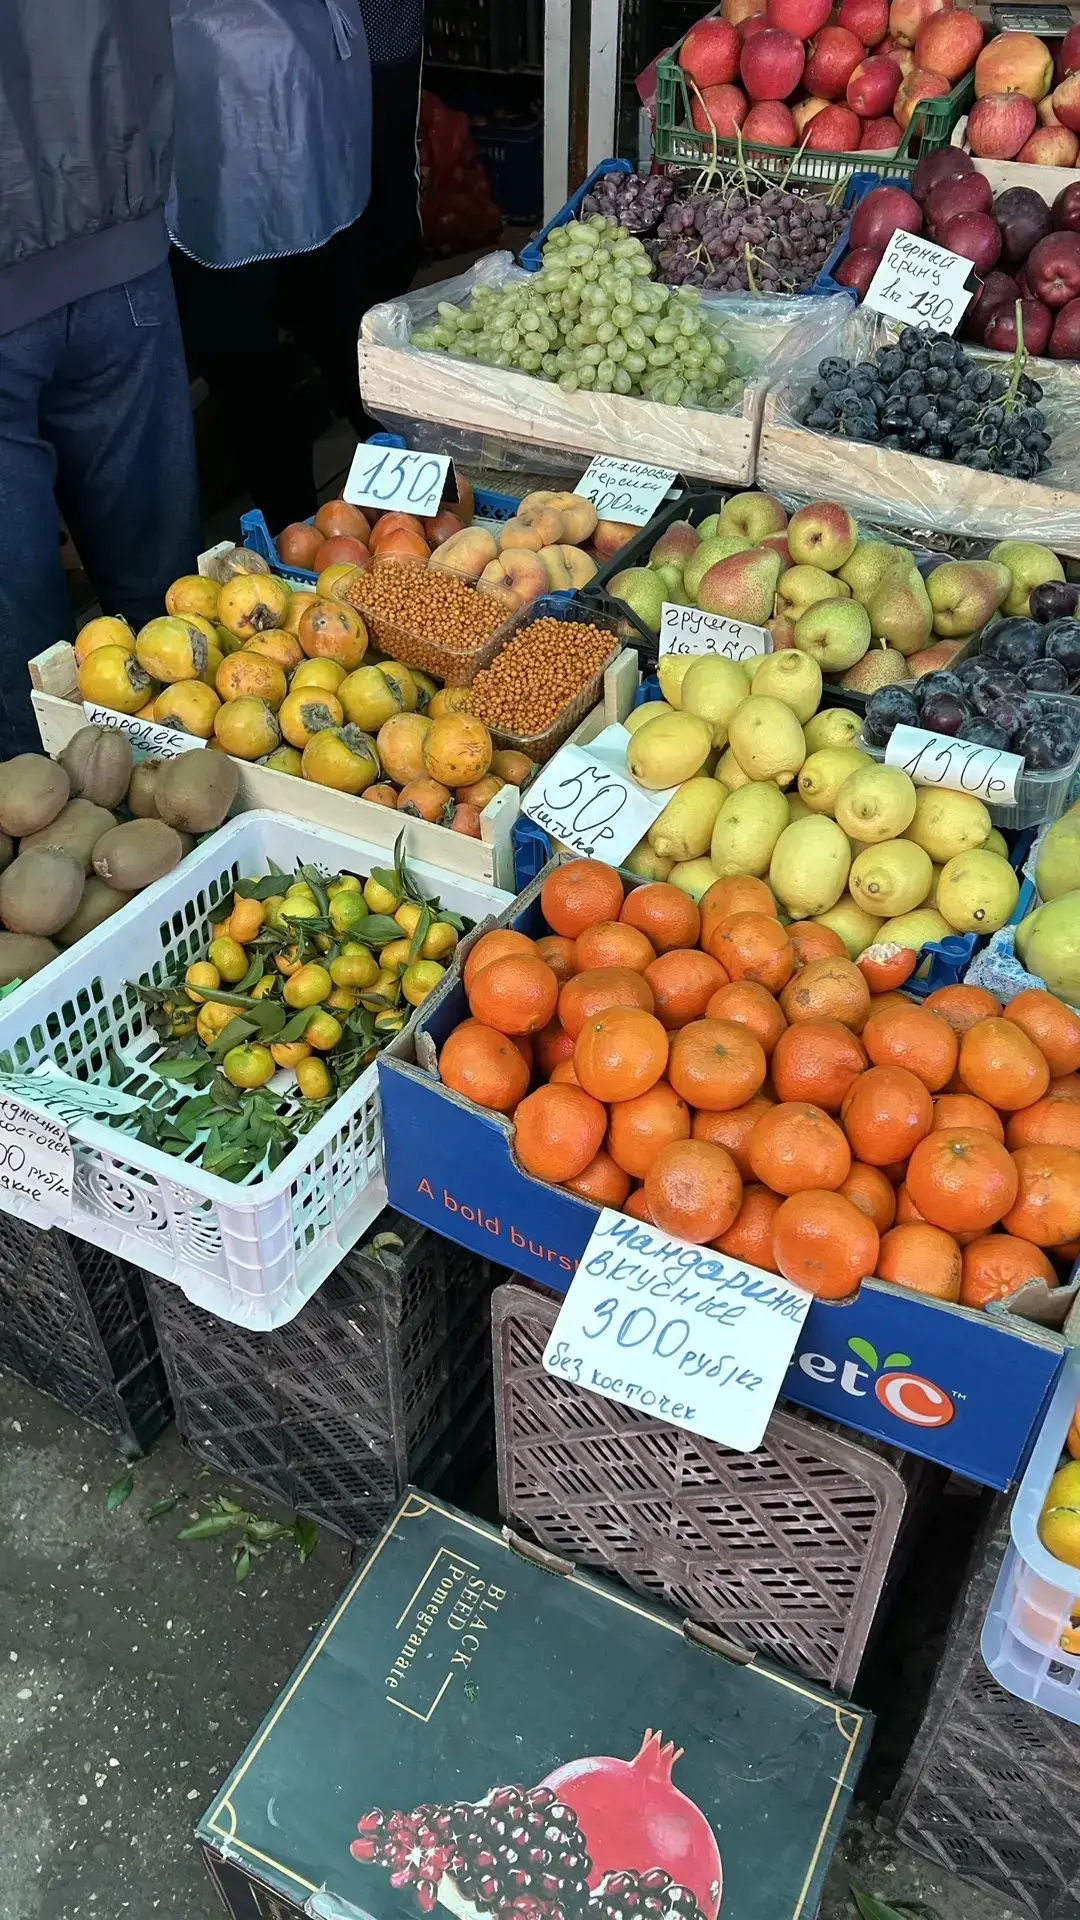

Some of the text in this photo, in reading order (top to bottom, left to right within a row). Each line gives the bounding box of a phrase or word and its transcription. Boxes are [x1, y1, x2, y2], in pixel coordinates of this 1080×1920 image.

[416, 1177, 435, 1200] A
[443, 1189, 501, 1236] bold
[591, 1369, 696, 1420] косточек
[384, 1564, 466, 1688] Pomegranate
[447, 1575, 486, 1631] SEED
[450, 1583, 507, 1670] BLACK
